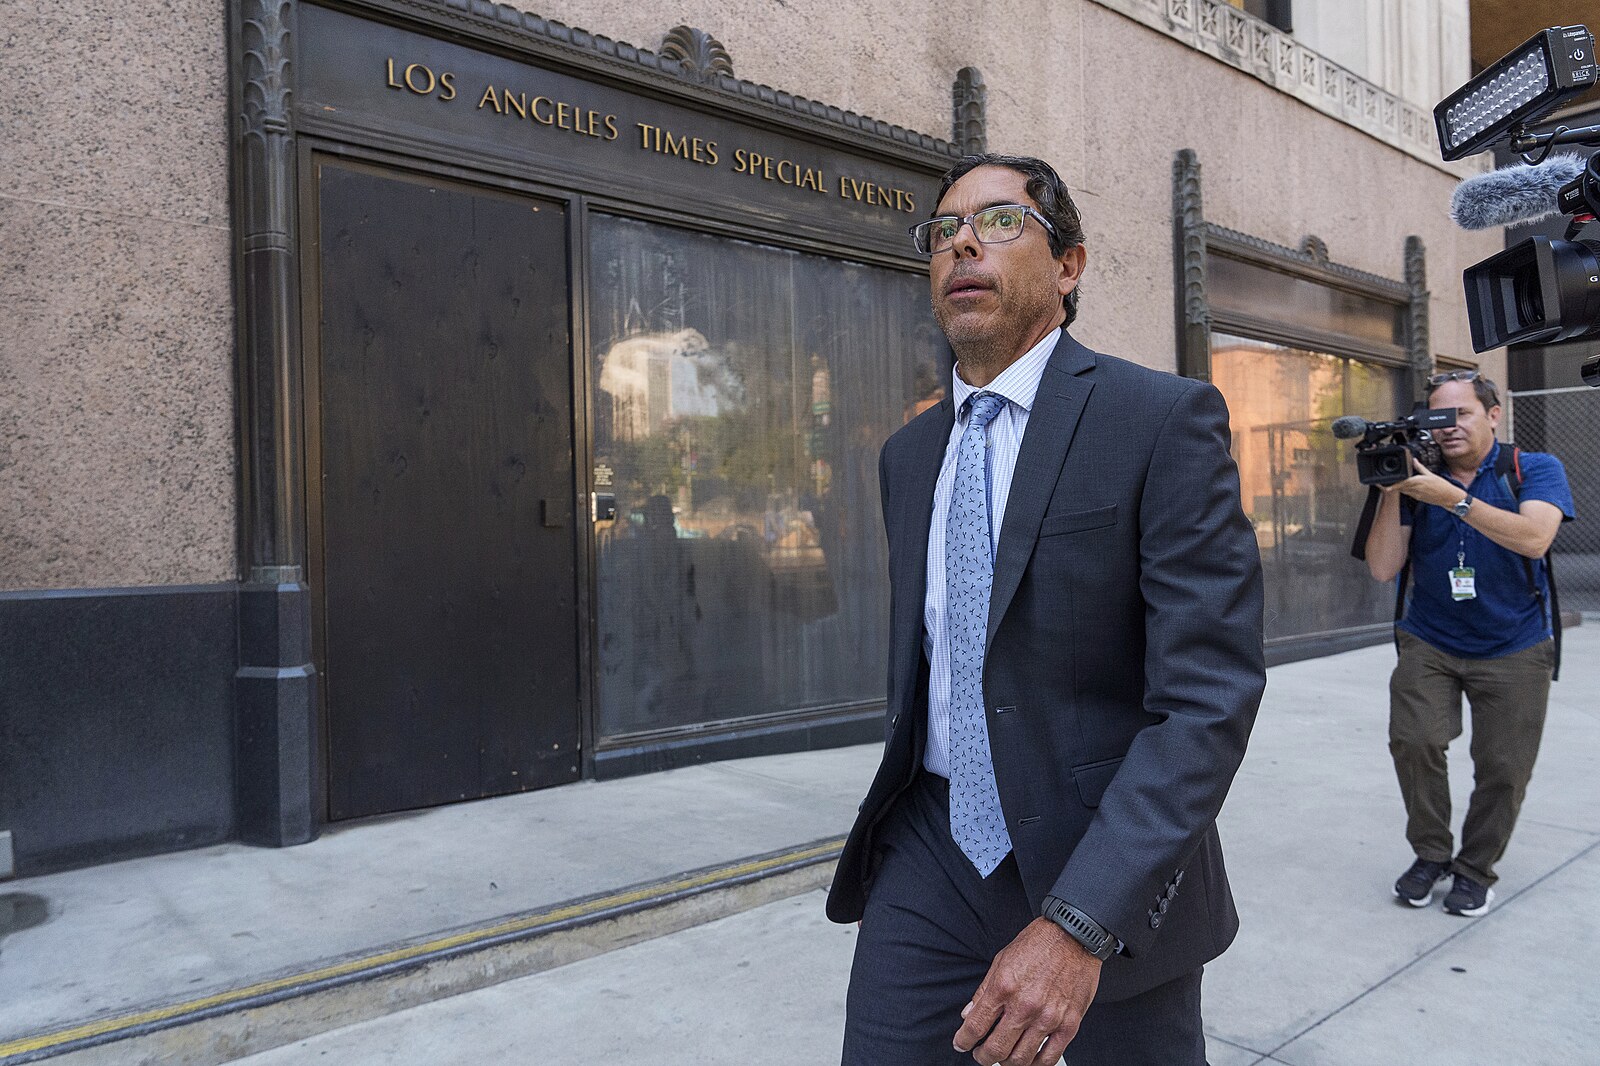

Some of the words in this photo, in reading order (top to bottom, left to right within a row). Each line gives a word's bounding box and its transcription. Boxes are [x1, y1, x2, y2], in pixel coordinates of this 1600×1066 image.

[386, 57, 456, 100] LOS
[478, 85, 619, 140] ANGELES
[637, 123, 719, 165] TIMES
[734, 149, 828, 193] SPECIAL
[841, 176, 915, 213] EVENTS
